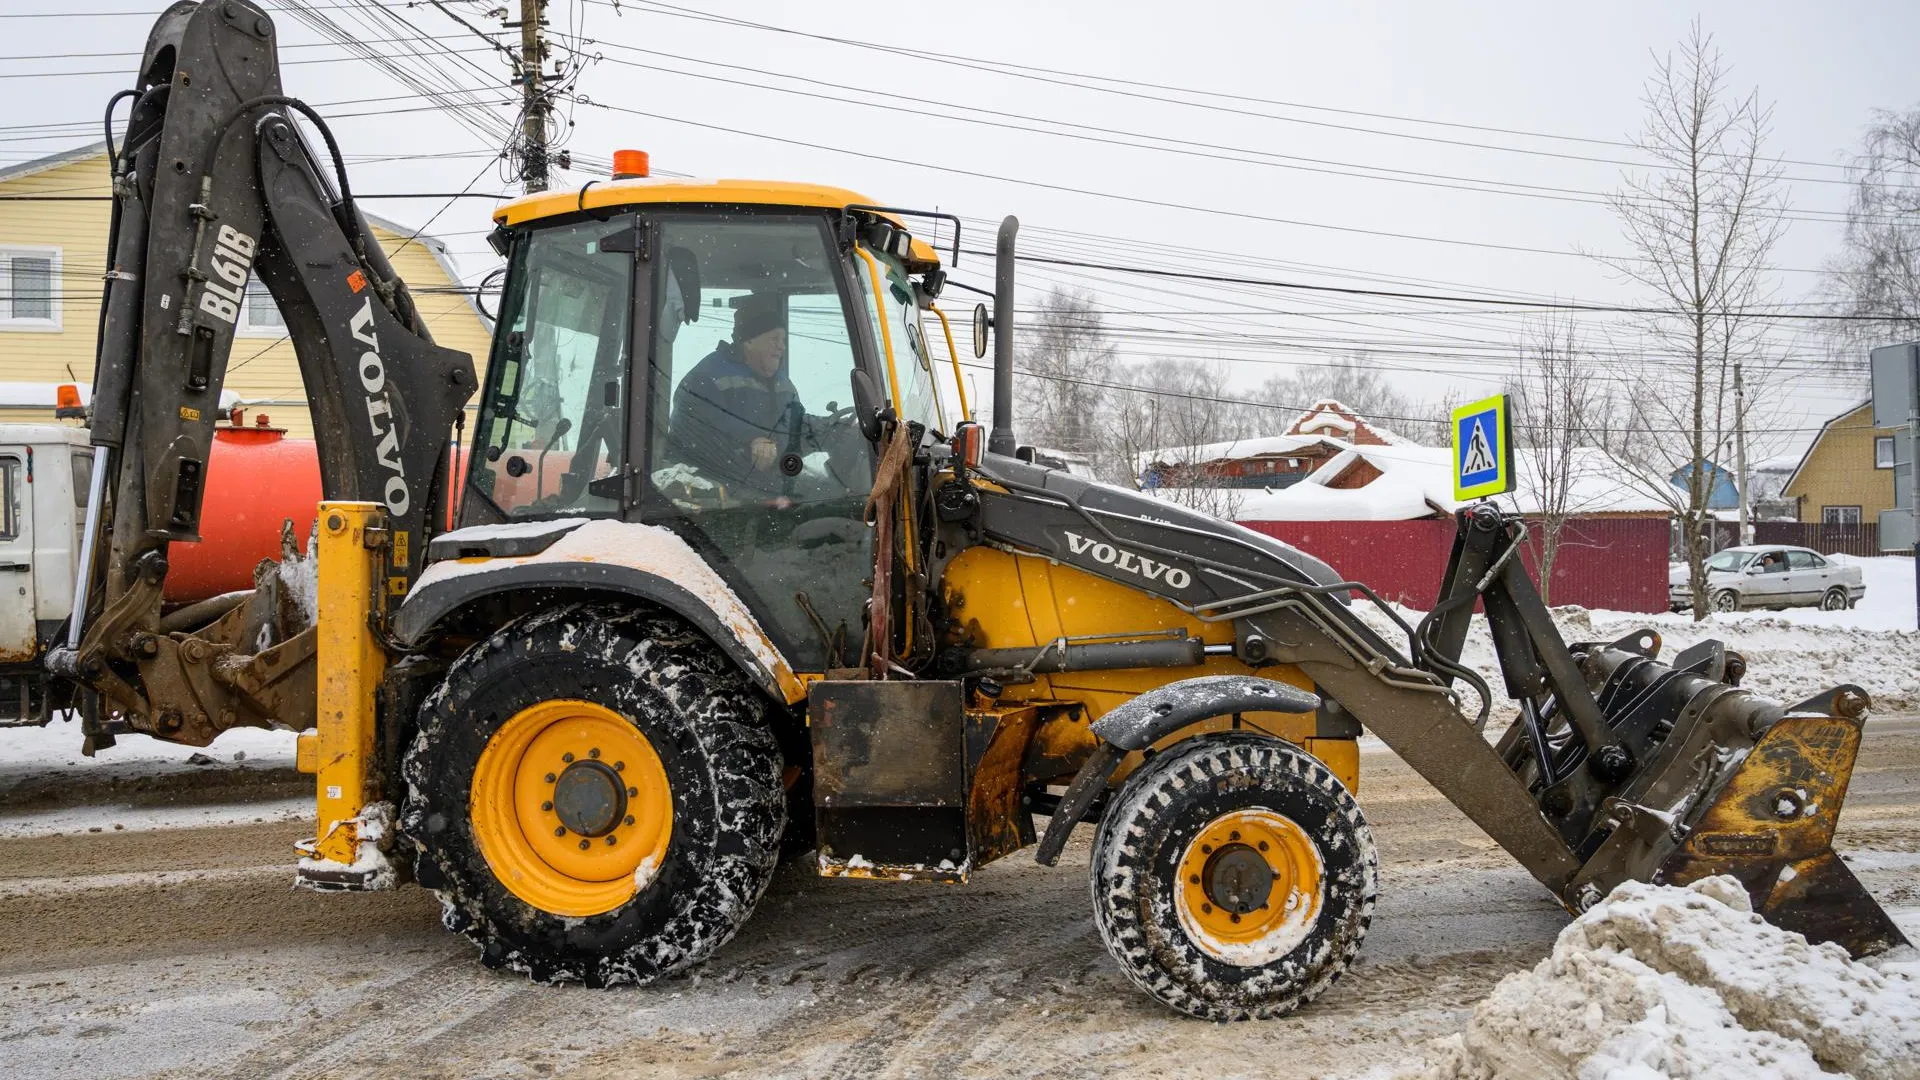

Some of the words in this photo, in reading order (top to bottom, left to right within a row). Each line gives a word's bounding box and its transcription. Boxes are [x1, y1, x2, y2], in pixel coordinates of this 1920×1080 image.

[200, 225, 255, 324] BL61B
[350, 297, 409, 516] VOLVO
[1064, 531, 1191, 588] VOLVO
